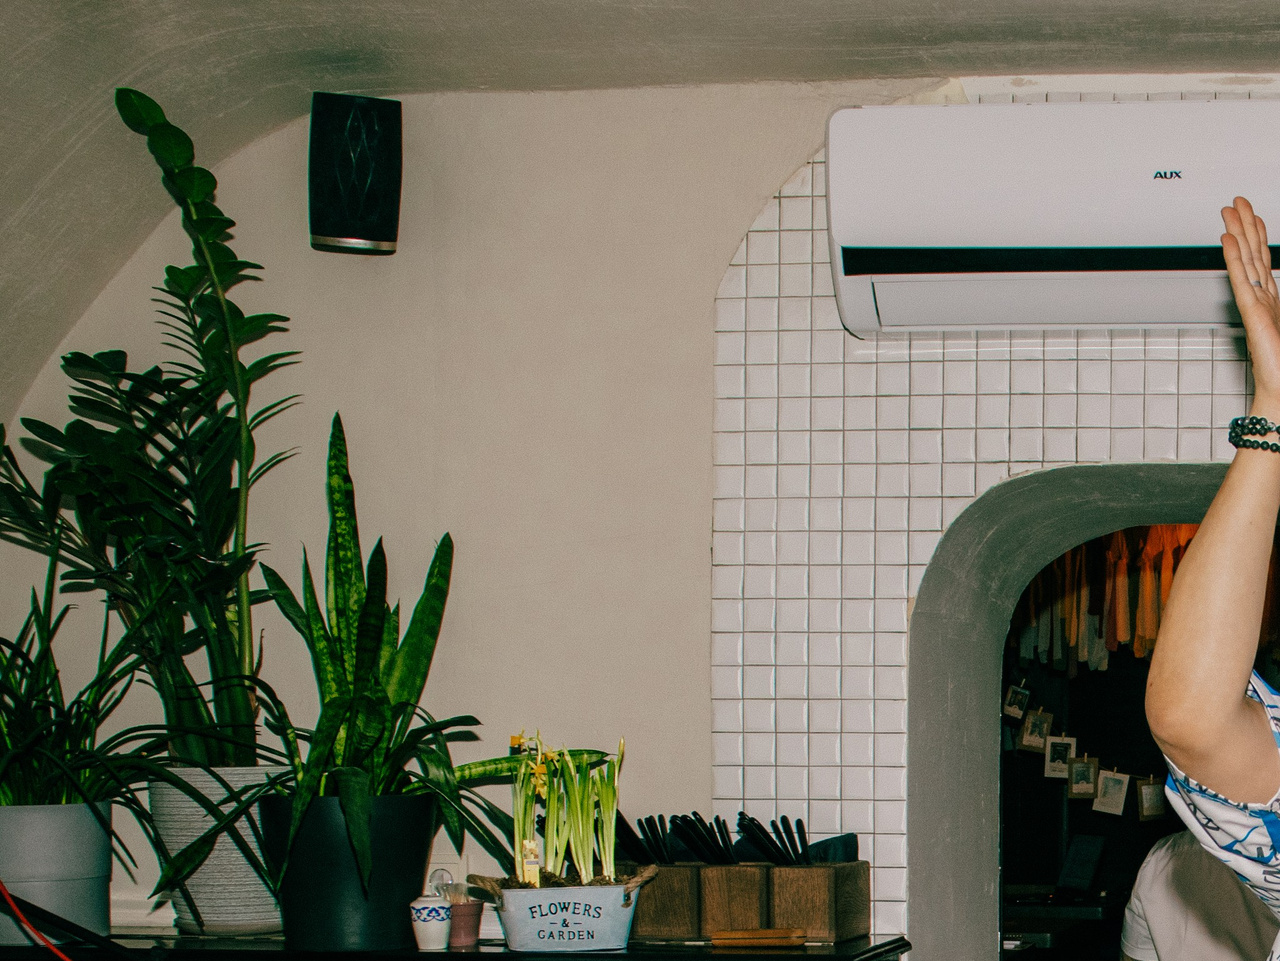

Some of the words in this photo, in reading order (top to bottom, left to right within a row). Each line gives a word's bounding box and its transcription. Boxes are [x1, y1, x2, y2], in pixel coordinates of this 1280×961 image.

[1153, 171, 1182, 180] AUX
[528, 901, 603, 919] FLOWERS
[561, 918, 571, 928] &
[537, 929, 596, 940] GARDEN
